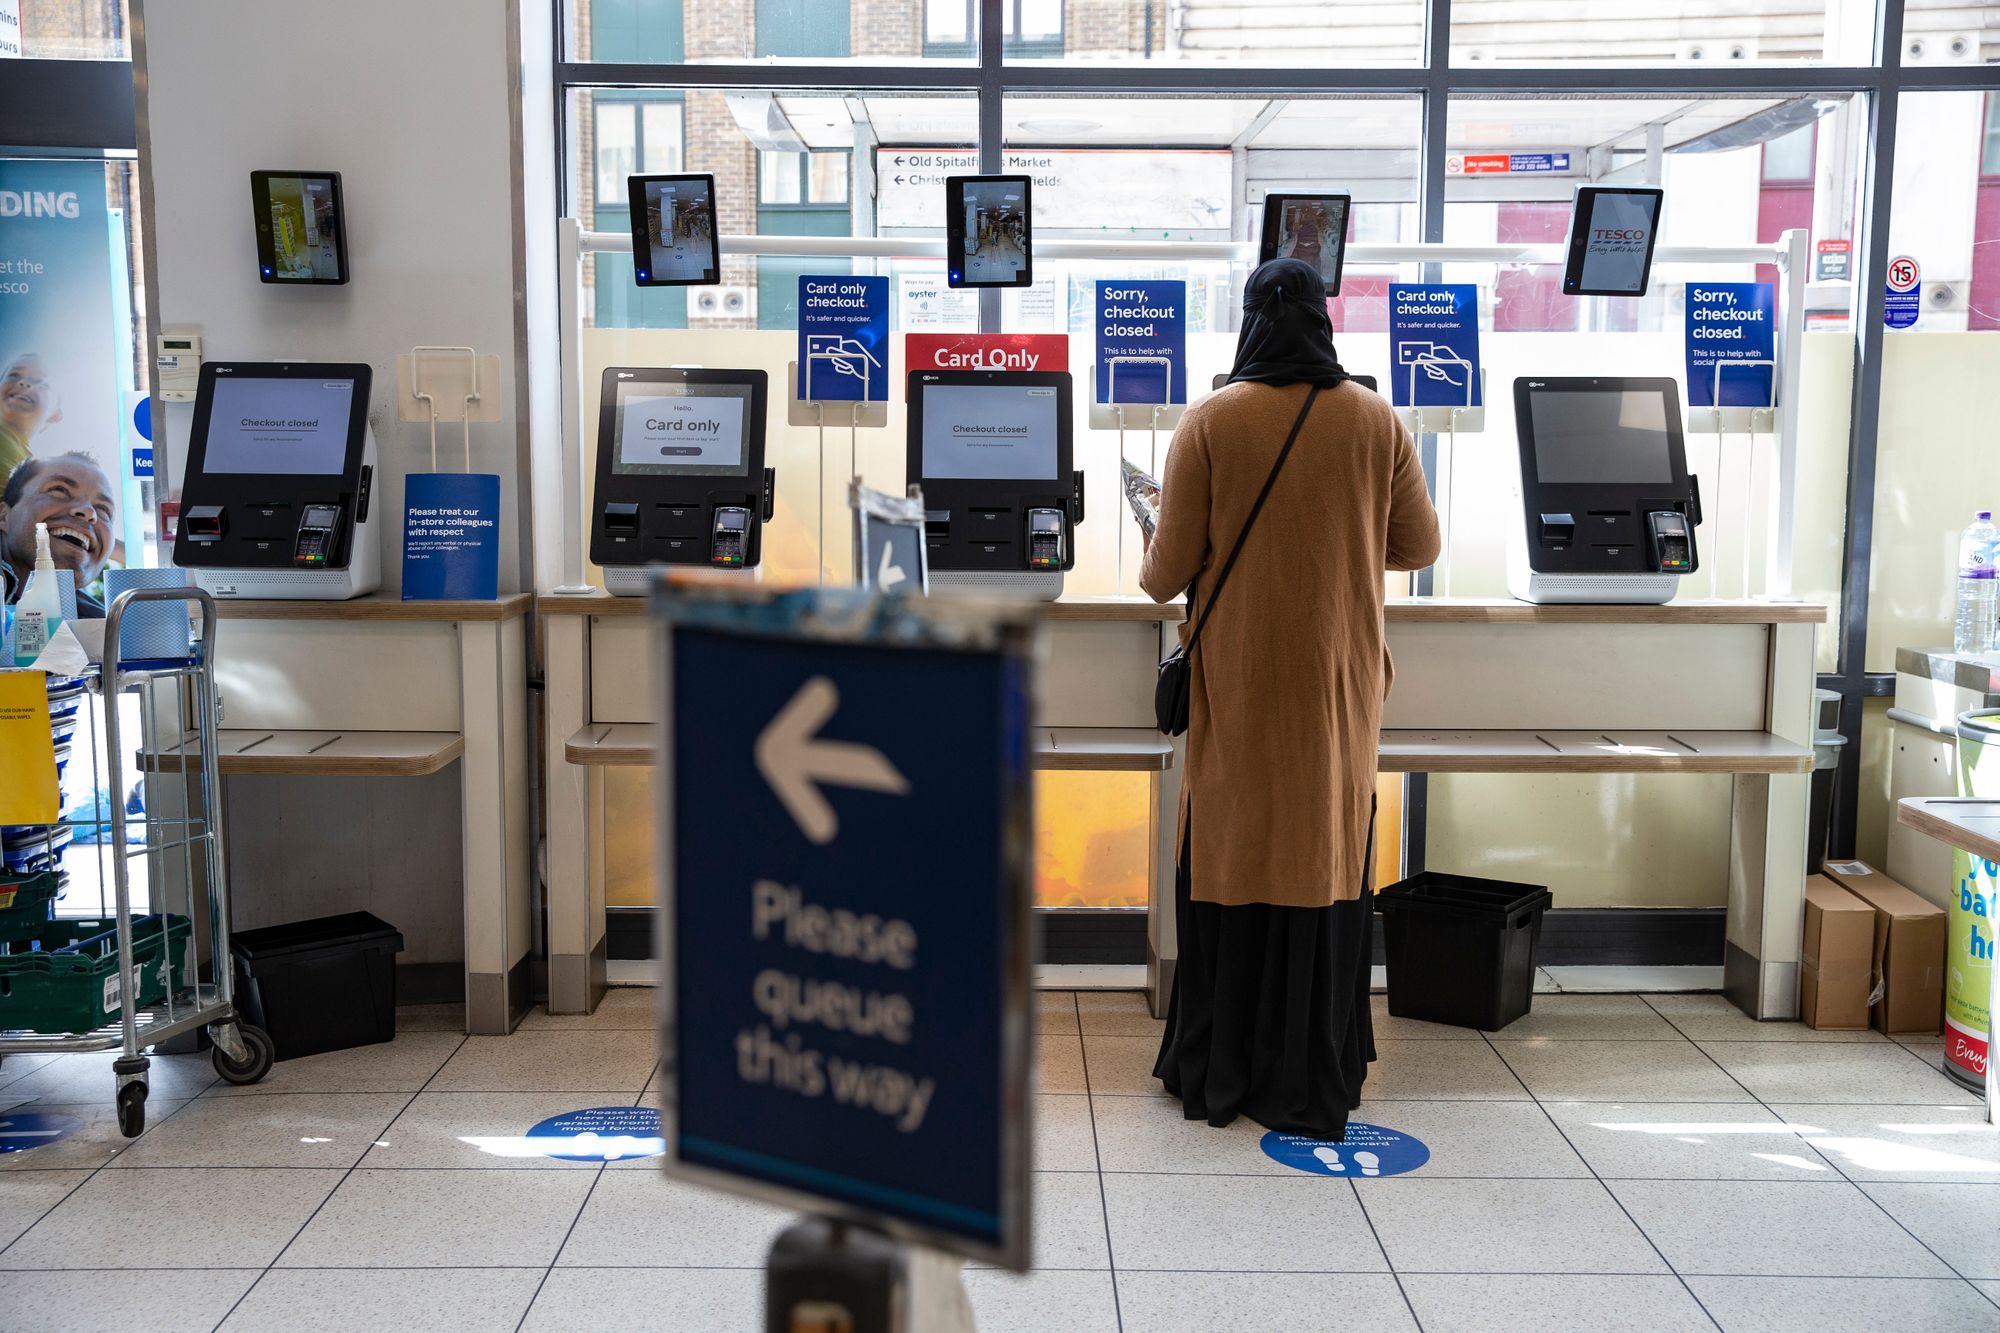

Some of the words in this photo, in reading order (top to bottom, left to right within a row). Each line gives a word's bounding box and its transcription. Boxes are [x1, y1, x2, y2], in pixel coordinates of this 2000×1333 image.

[909, 156, 931, 167] Old
[936, 156, 1005, 169] Spitalfis
[1009, 156, 1052, 168] Market
[0, 191, 80, 218] DING
[1594, 229, 1645, 240] TESCO
[1589, 244, 1608, 255] Every
[17, 258, 44, 274] the
[1893, 266, 1912, 282] 15
[0, 282, 29, 294] sco
[806, 283, 837, 294] Card
[840, 283, 867, 296] only
[908, 290, 937, 300] oyster
[1104, 286, 1149, 303] Sorry,
[1397, 290, 1426, 301] Card
[1429, 290, 1455, 304] only
[1693, 288, 1738, 305] Sorry,
[806, 296, 868, 308] checkout.
[1104, 305, 1175, 319] checkout
[1397, 303, 1458, 315] checkout.
[1693, 307, 1763, 321] checkout
[847, 316, 872, 324] quicker.
[1437, 322, 1462, 330] quicker.
[1104, 323, 1158, 337] closed.
[1693, 325, 1747, 339] closed.
[1104, 347, 1119, 355] This
[1121, 347, 1127, 355] is
[1128, 347, 1137, 355] to
[1139, 347, 1155, 357] help
[1156, 347, 1173, 355] with
[1693, 349, 1708, 357] This
[1710, 349, 1716, 357] is
[1717, 349, 1726, 357] to
[1727, 349, 1744, 358] help
[1745, 349, 1762, 357] with
[934, 348, 983, 368] Card
[989, 348, 1040, 372] Only
[1693, 358, 1715, 366] social
[241, 418, 285, 427] Checkout
[287, 419, 318, 428] closed
[646, 418, 682, 431] Card
[687, 419, 720, 434] only
[952, 425, 995, 433] Checkout
[998, 425, 1028, 433] closed
[136, 458, 153, 467] Kee
[409, 508, 437, 516] Please
[439, 508, 461, 516] treat
[408, 518, 444, 526] in-store
[446, 518, 493, 528] colleagues
[429, 529, 464, 537] respect
[752, 878, 918, 970] Please
[753, 968, 914, 1045] queue
[734, 1023, 826, 1098] this
[827, 1056, 936, 1133] way
